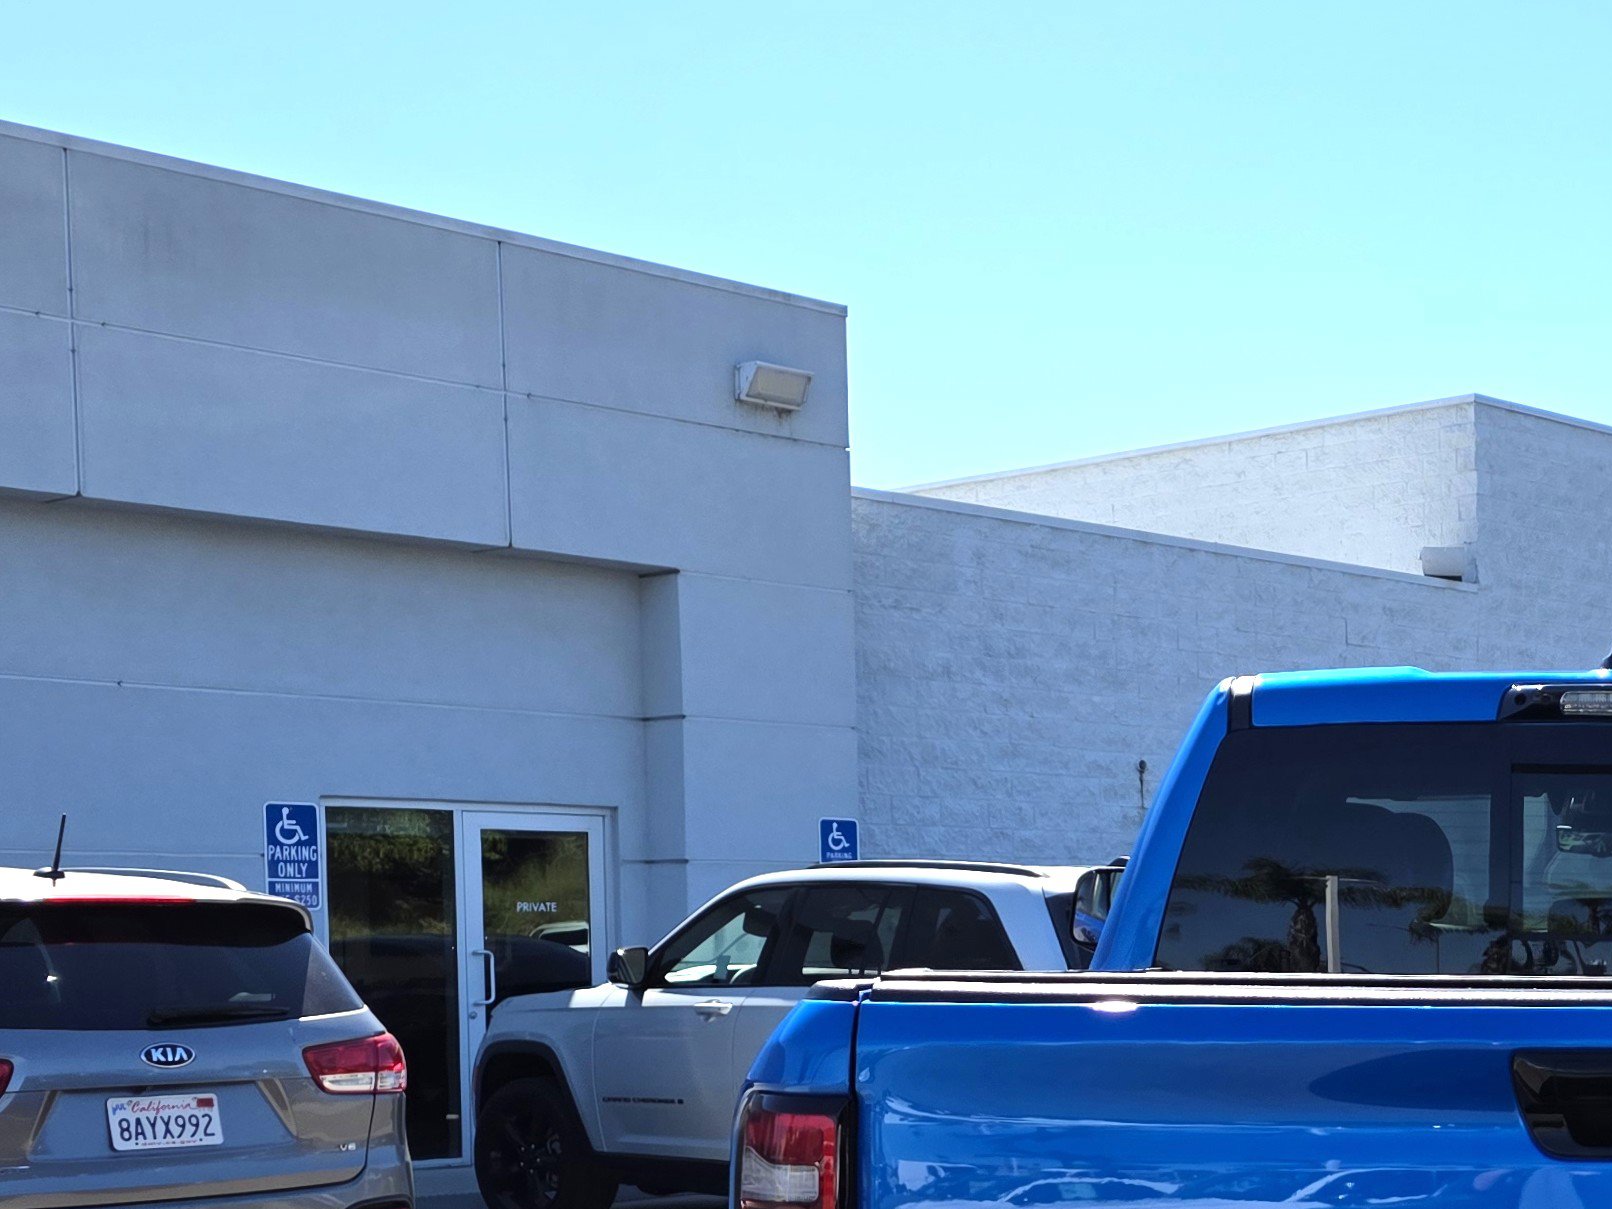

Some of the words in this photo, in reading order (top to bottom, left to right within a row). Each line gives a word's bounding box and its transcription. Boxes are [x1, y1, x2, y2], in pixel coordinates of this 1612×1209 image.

[268, 845, 317, 861] PARKING
[278, 862, 308, 878] ONLY
[275, 883, 313, 893] MINIMUM
[516, 901, 557, 912] PRIVATE
[150, 1047, 188, 1062] KIA
[131, 1100, 193, 1115] California
[118, 1113, 216, 1142] 8AYX992
